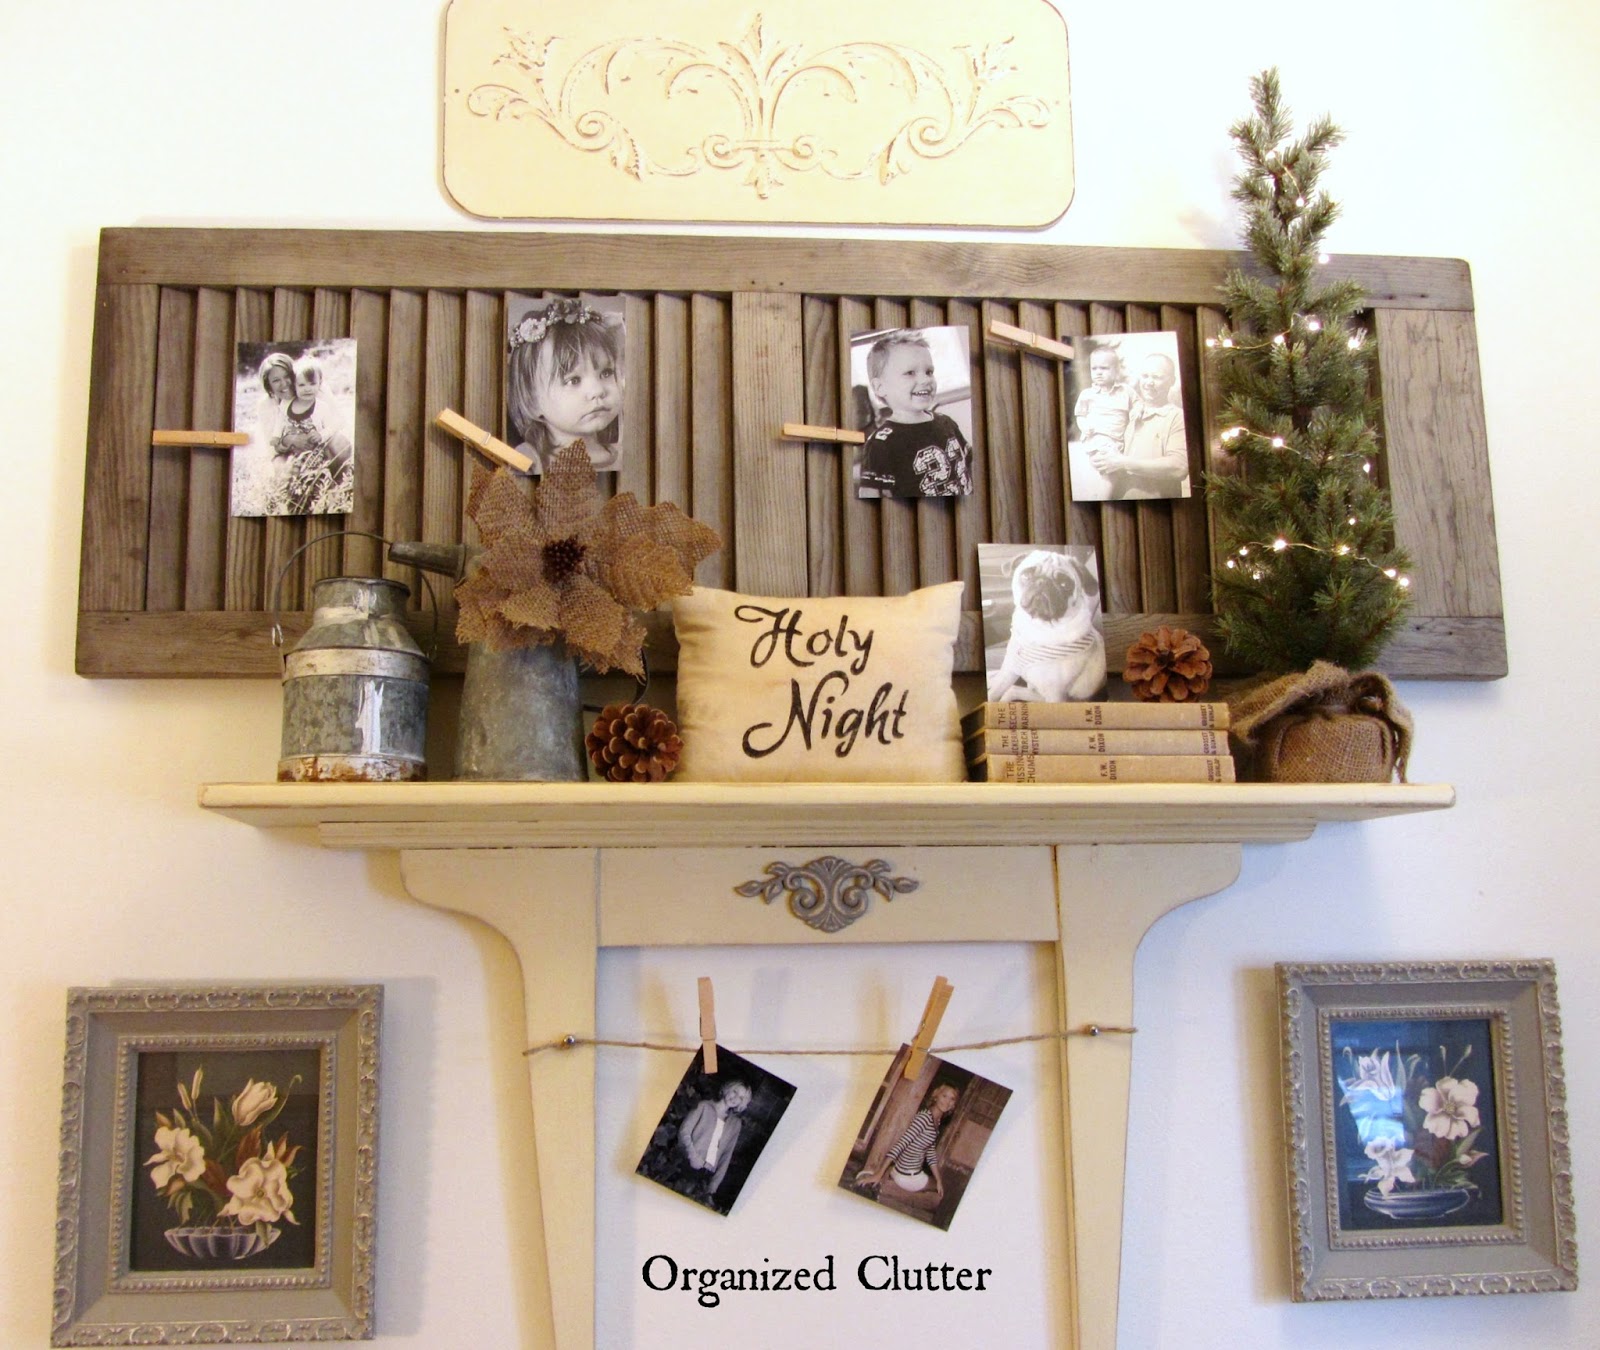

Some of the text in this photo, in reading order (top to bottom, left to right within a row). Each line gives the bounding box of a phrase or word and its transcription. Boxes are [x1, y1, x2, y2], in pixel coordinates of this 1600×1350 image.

[734, 605, 874, 675] Holy
[742, 670, 909, 758] Night
[998, 707, 1006, 725] THE
[1009, 702, 1018, 729] SECRET
[1021, 702, 1029, 729] ARNIN
[1094, 705, 1102, 725] DIXON
[1006, 761, 1014, 778] THE
[1017, 753, 1025, 783] ISSIN
[1109, 760, 1117, 780] DIXON
